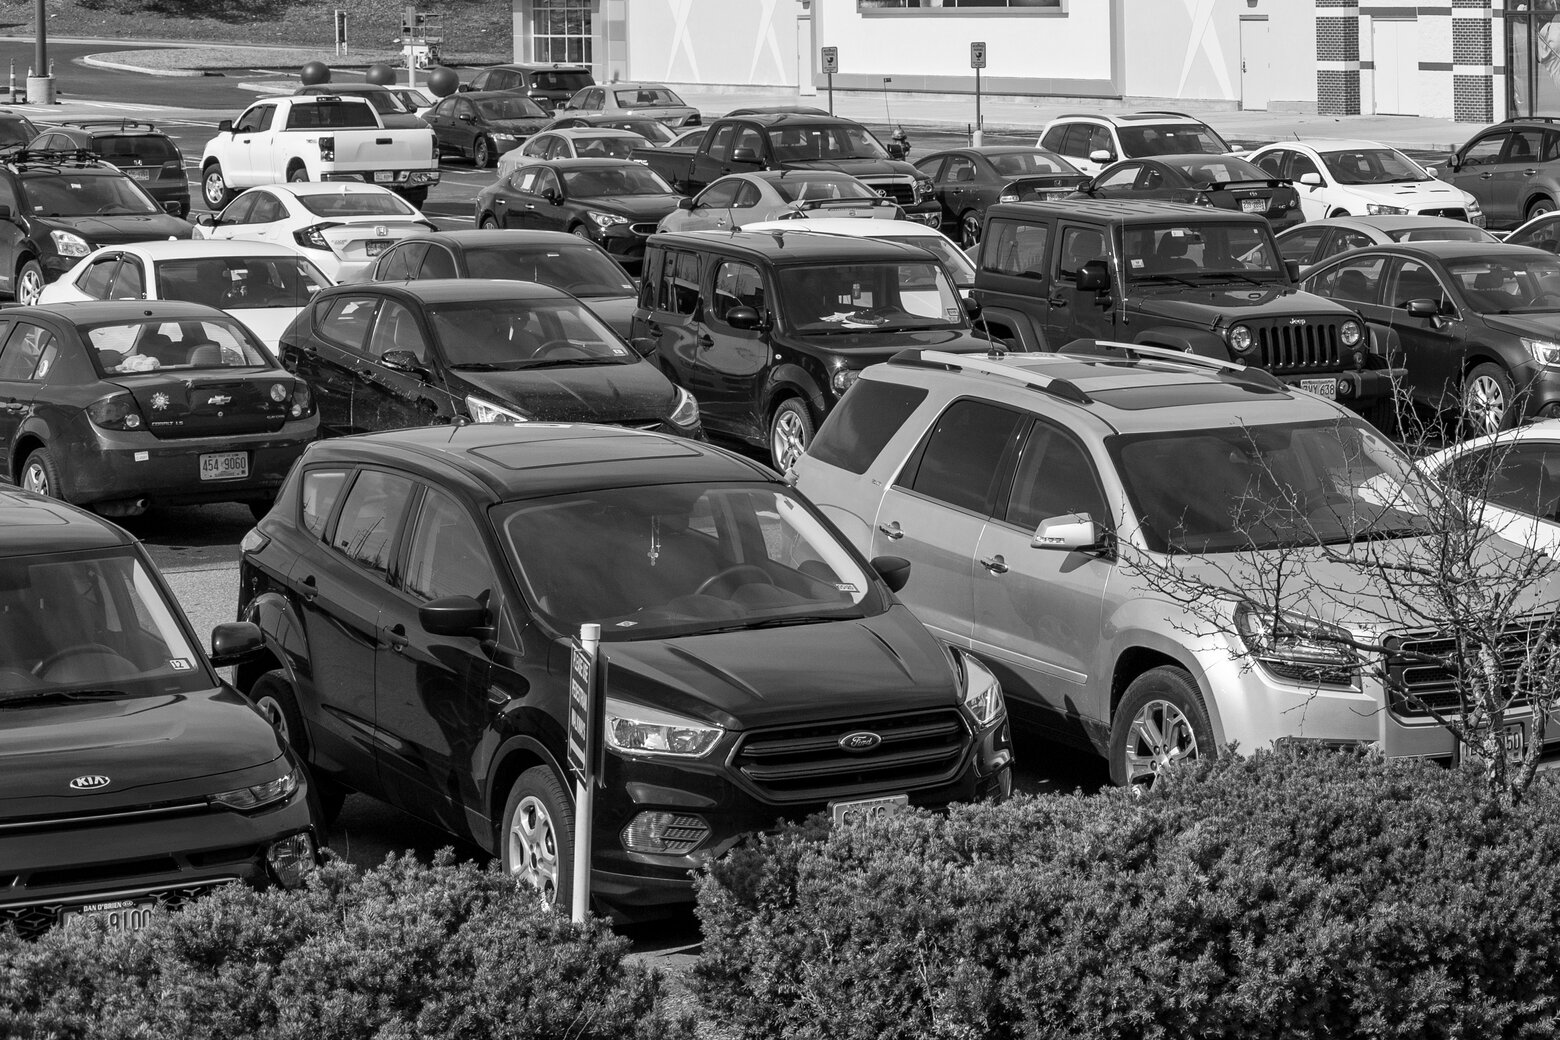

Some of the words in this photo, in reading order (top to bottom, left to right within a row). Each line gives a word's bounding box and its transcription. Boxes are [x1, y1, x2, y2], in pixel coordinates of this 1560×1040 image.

[1320, 384, 1335, 395] 638
[202, 458, 219, 472] 454
[224, 456, 246, 470] 9060
[850, 735, 873, 748] Ford
[75, 775, 106, 788] KIA
[83, 904, 97, 912] DAN
[97, 901, 122, 911] O'BRIEN
